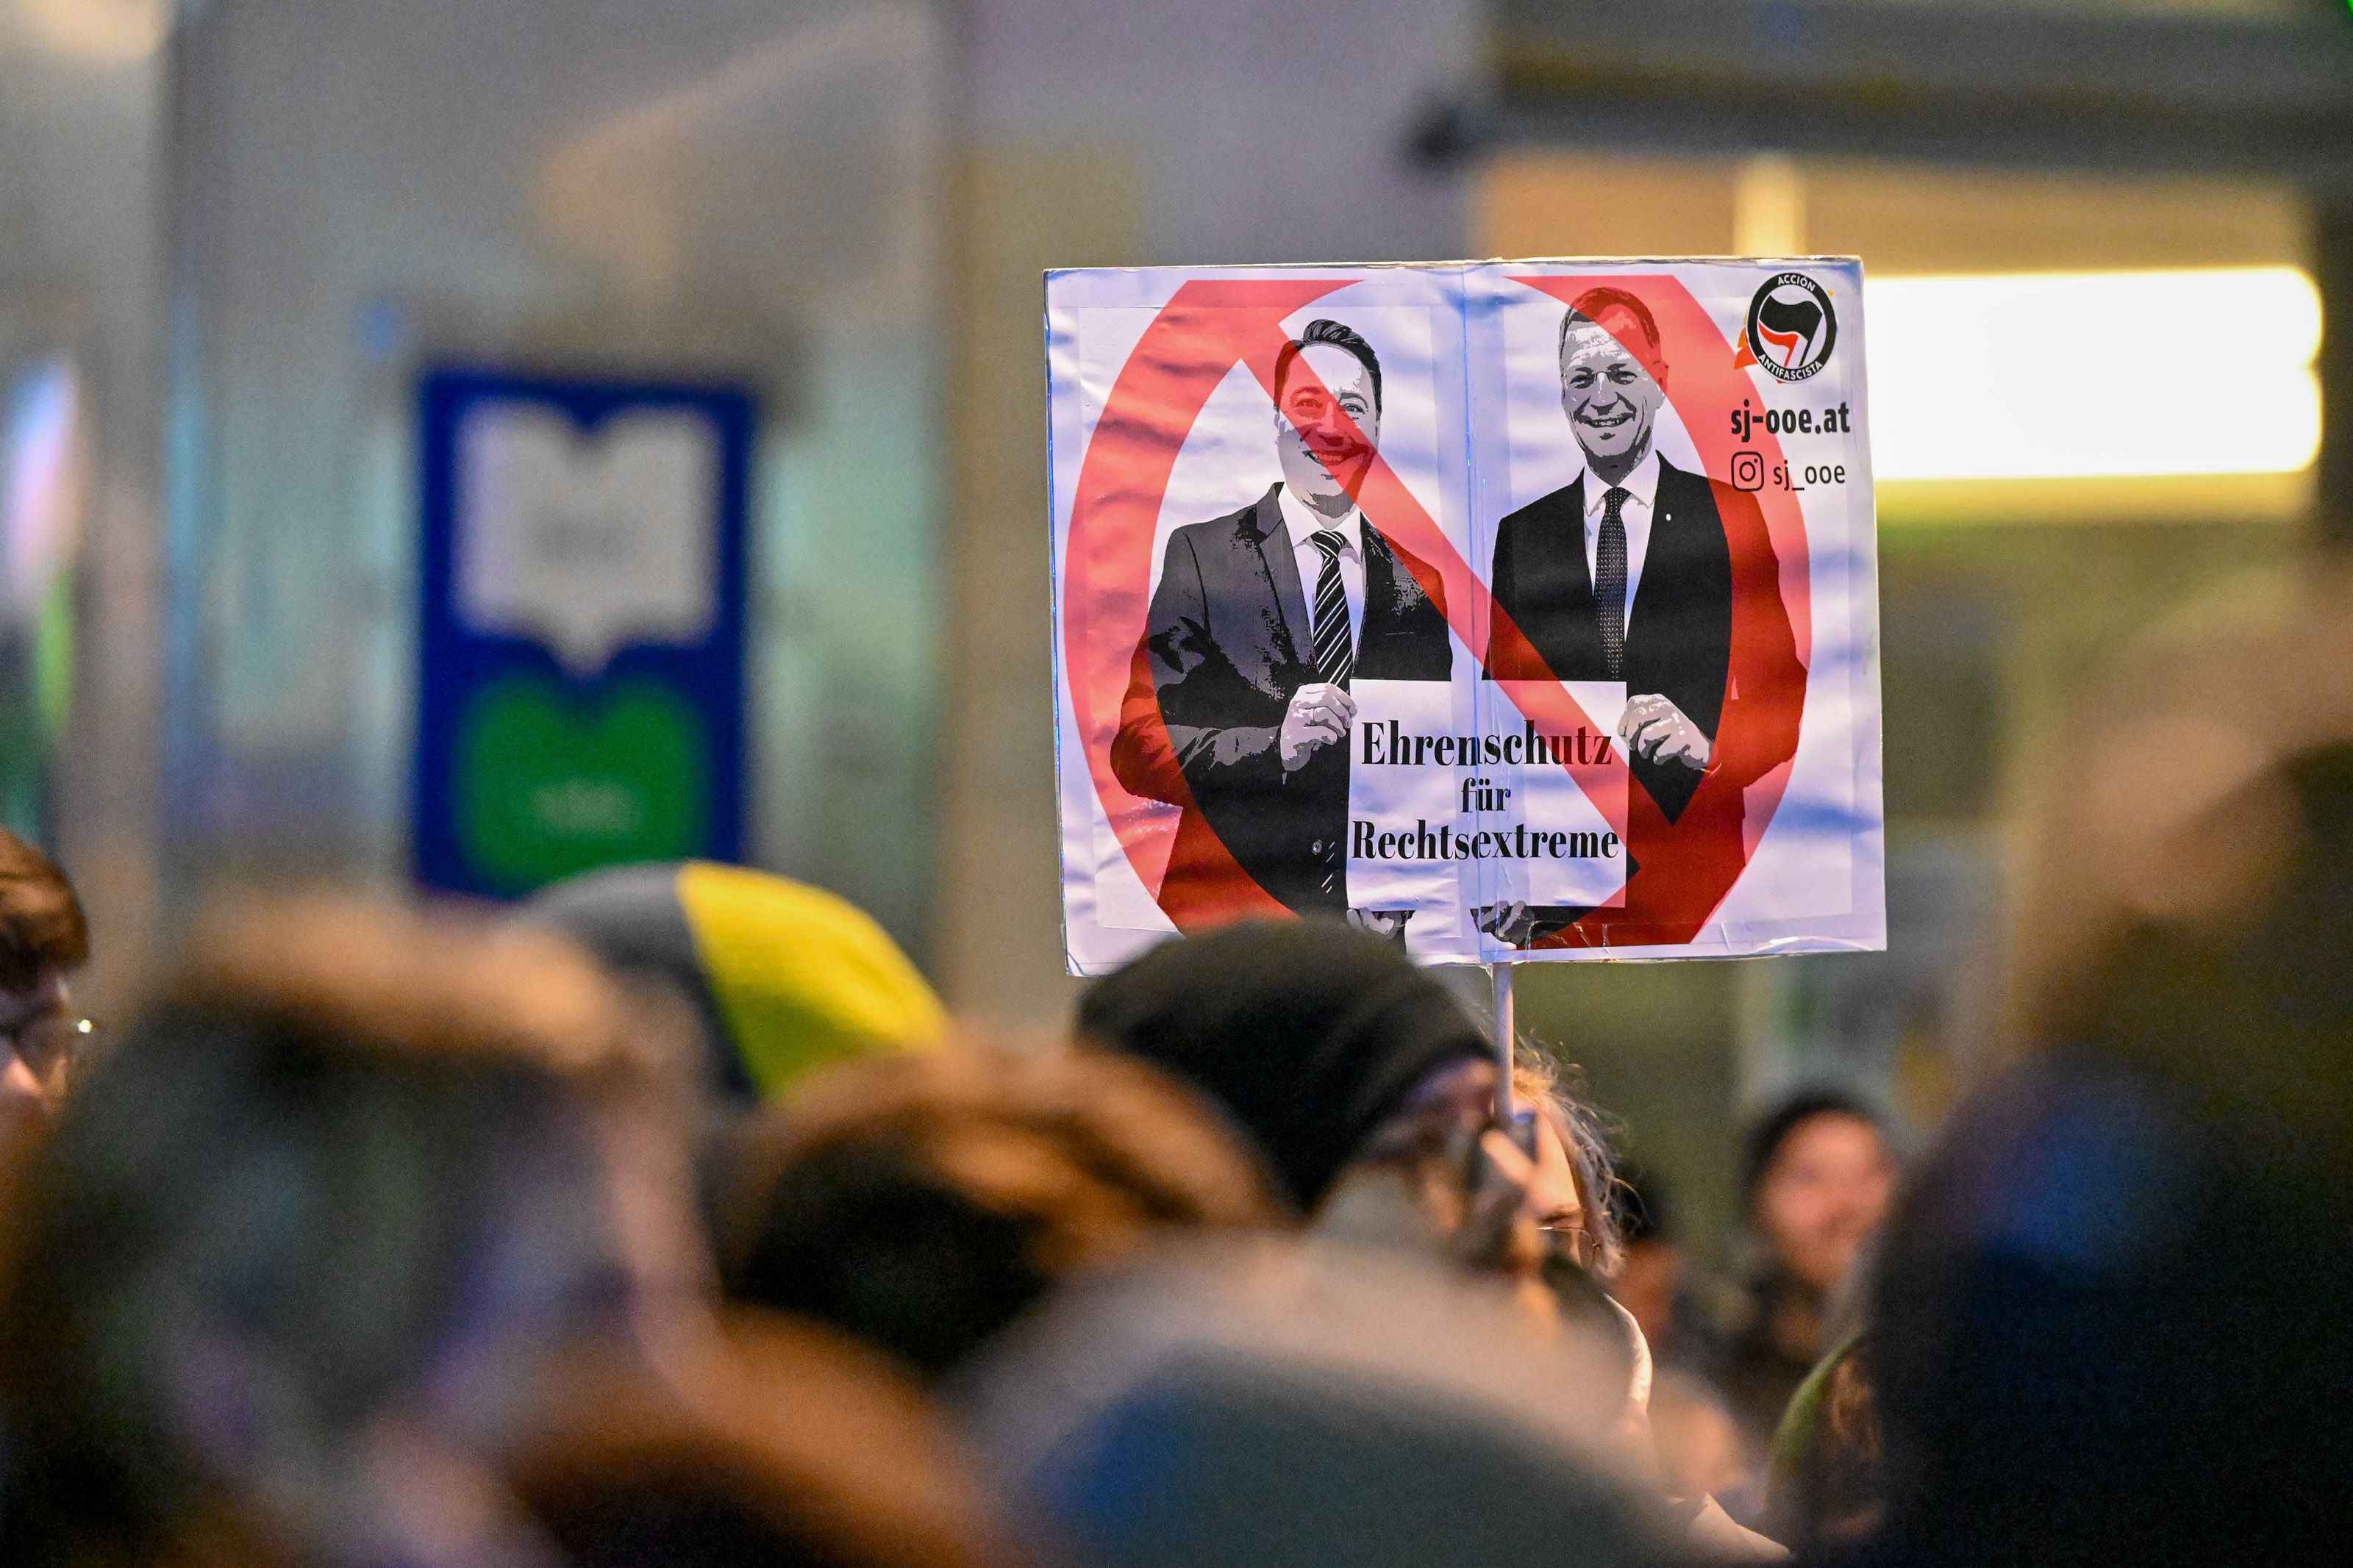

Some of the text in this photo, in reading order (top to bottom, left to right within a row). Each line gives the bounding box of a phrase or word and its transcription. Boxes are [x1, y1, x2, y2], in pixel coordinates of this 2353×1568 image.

[1758, 354, 1823, 381] ANTIFASCISTA
[1730, 399, 1850, 443] sj-ooe.at
[1773, 459, 1846, 491] sj_ooe
[1361, 720, 1613, 766] Ehrenschutz
[1460, 778, 1511, 813] für
[1352, 819, 1618, 860] Rechtsextreme
